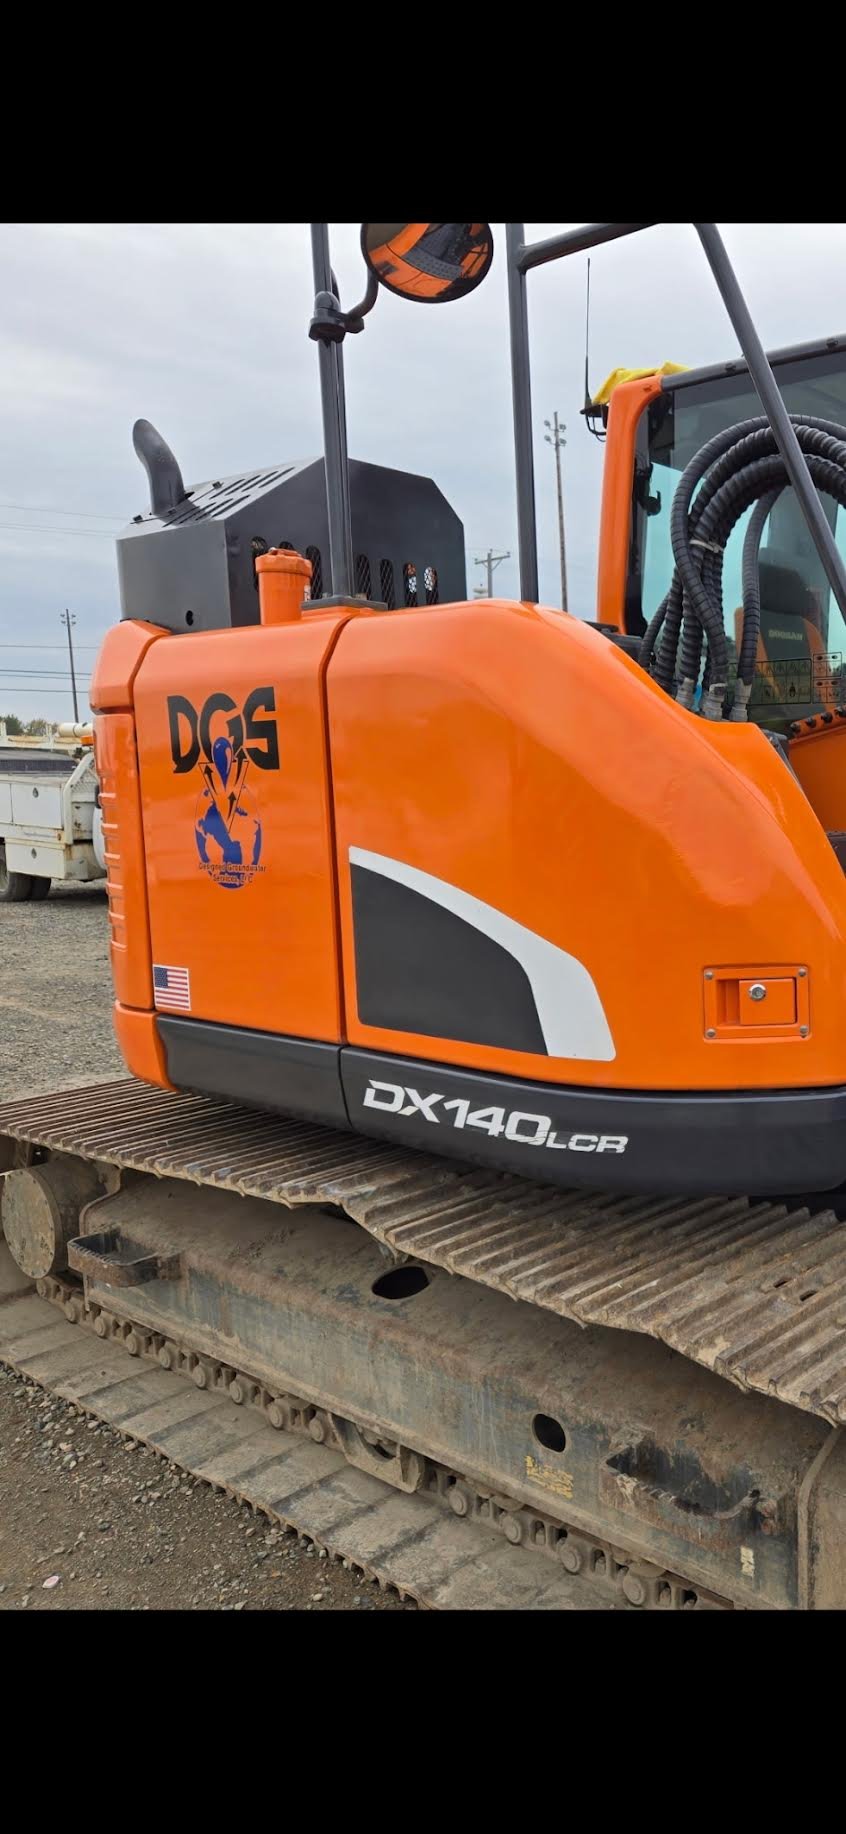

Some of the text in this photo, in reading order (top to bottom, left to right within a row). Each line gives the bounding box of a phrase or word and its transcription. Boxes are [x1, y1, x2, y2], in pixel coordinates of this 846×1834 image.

[167, 686, 280, 774] DGS
[198, 862, 266, 873] Designed Groundwater
